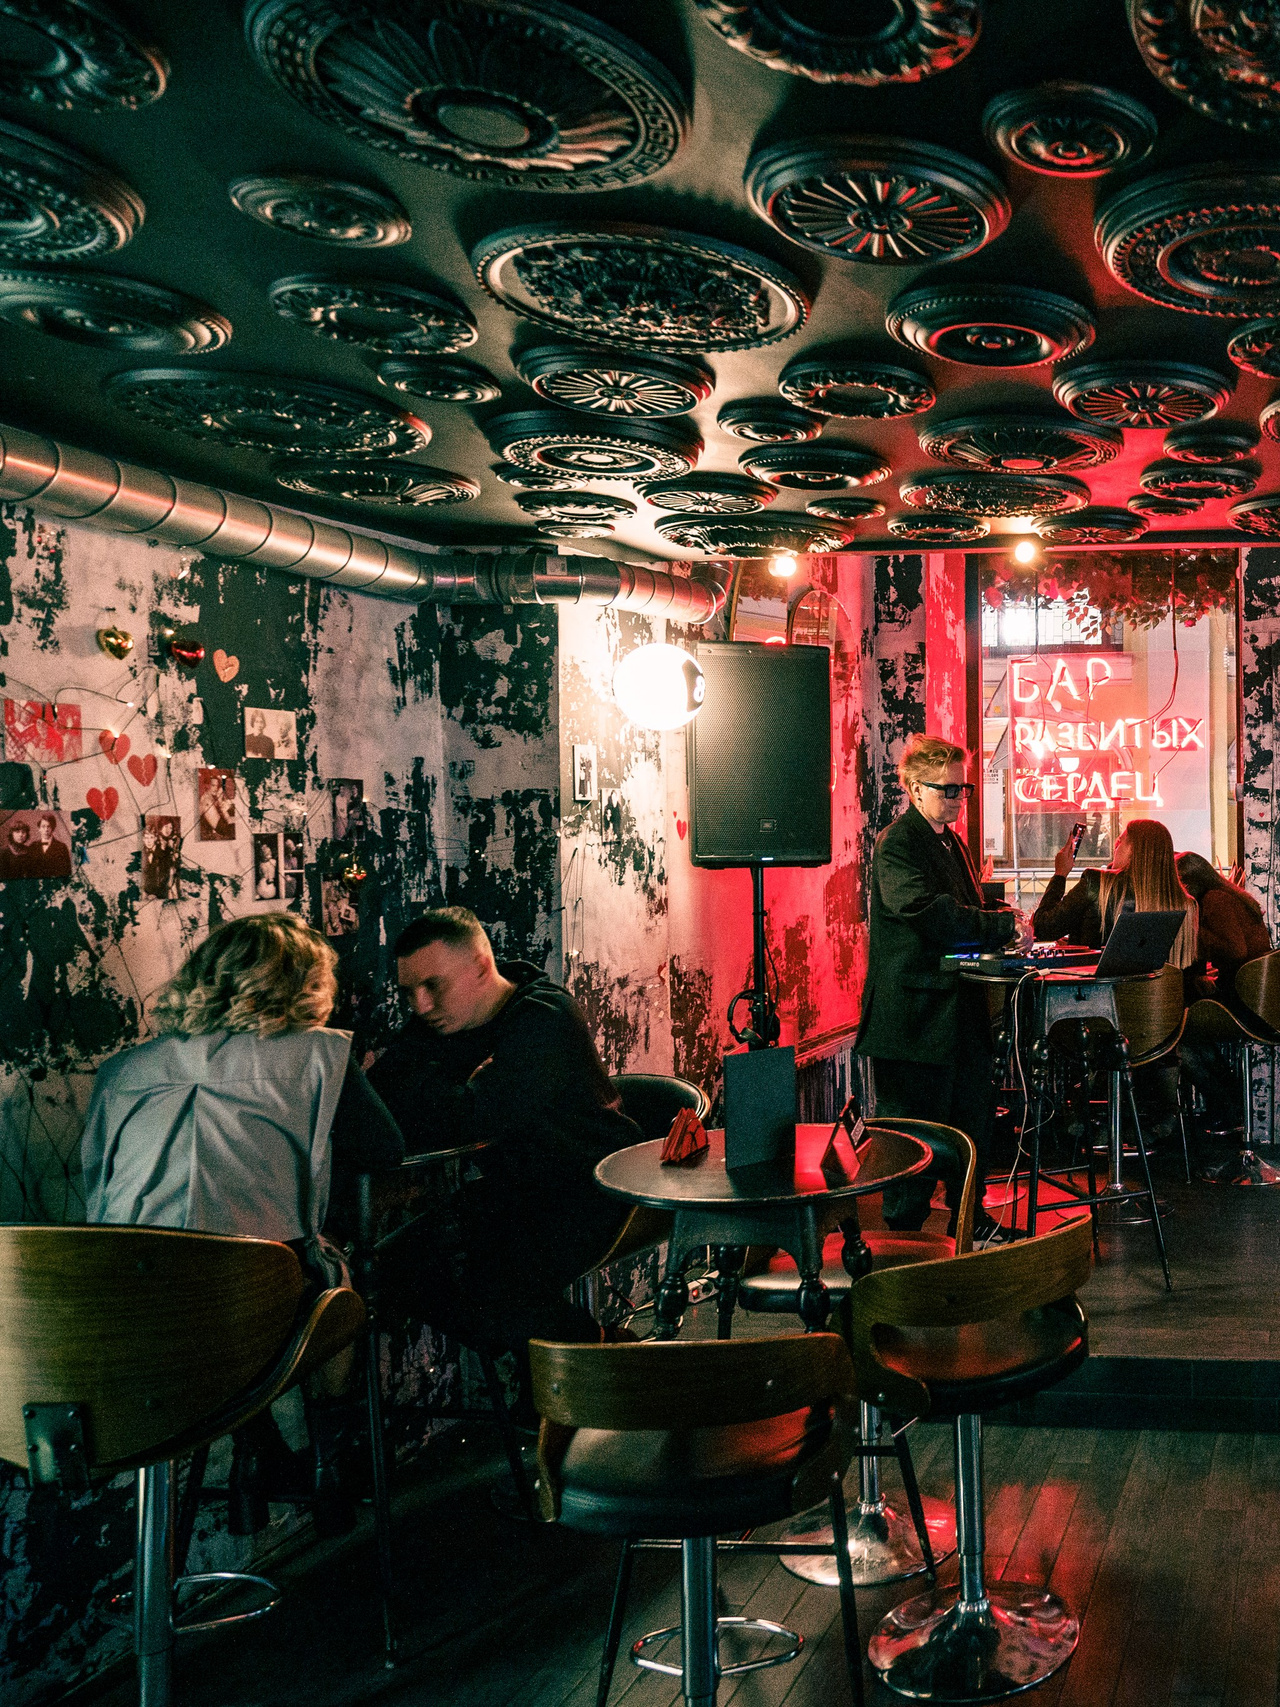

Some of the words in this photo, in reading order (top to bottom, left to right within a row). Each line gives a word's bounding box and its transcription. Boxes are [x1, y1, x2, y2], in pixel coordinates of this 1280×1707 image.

[1010, 657, 1112, 704] БАР
[1013, 717, 1204, 753] РАЗБИТЫХ
[1013, 771, 1164, 810] СЕРДЕЦ
